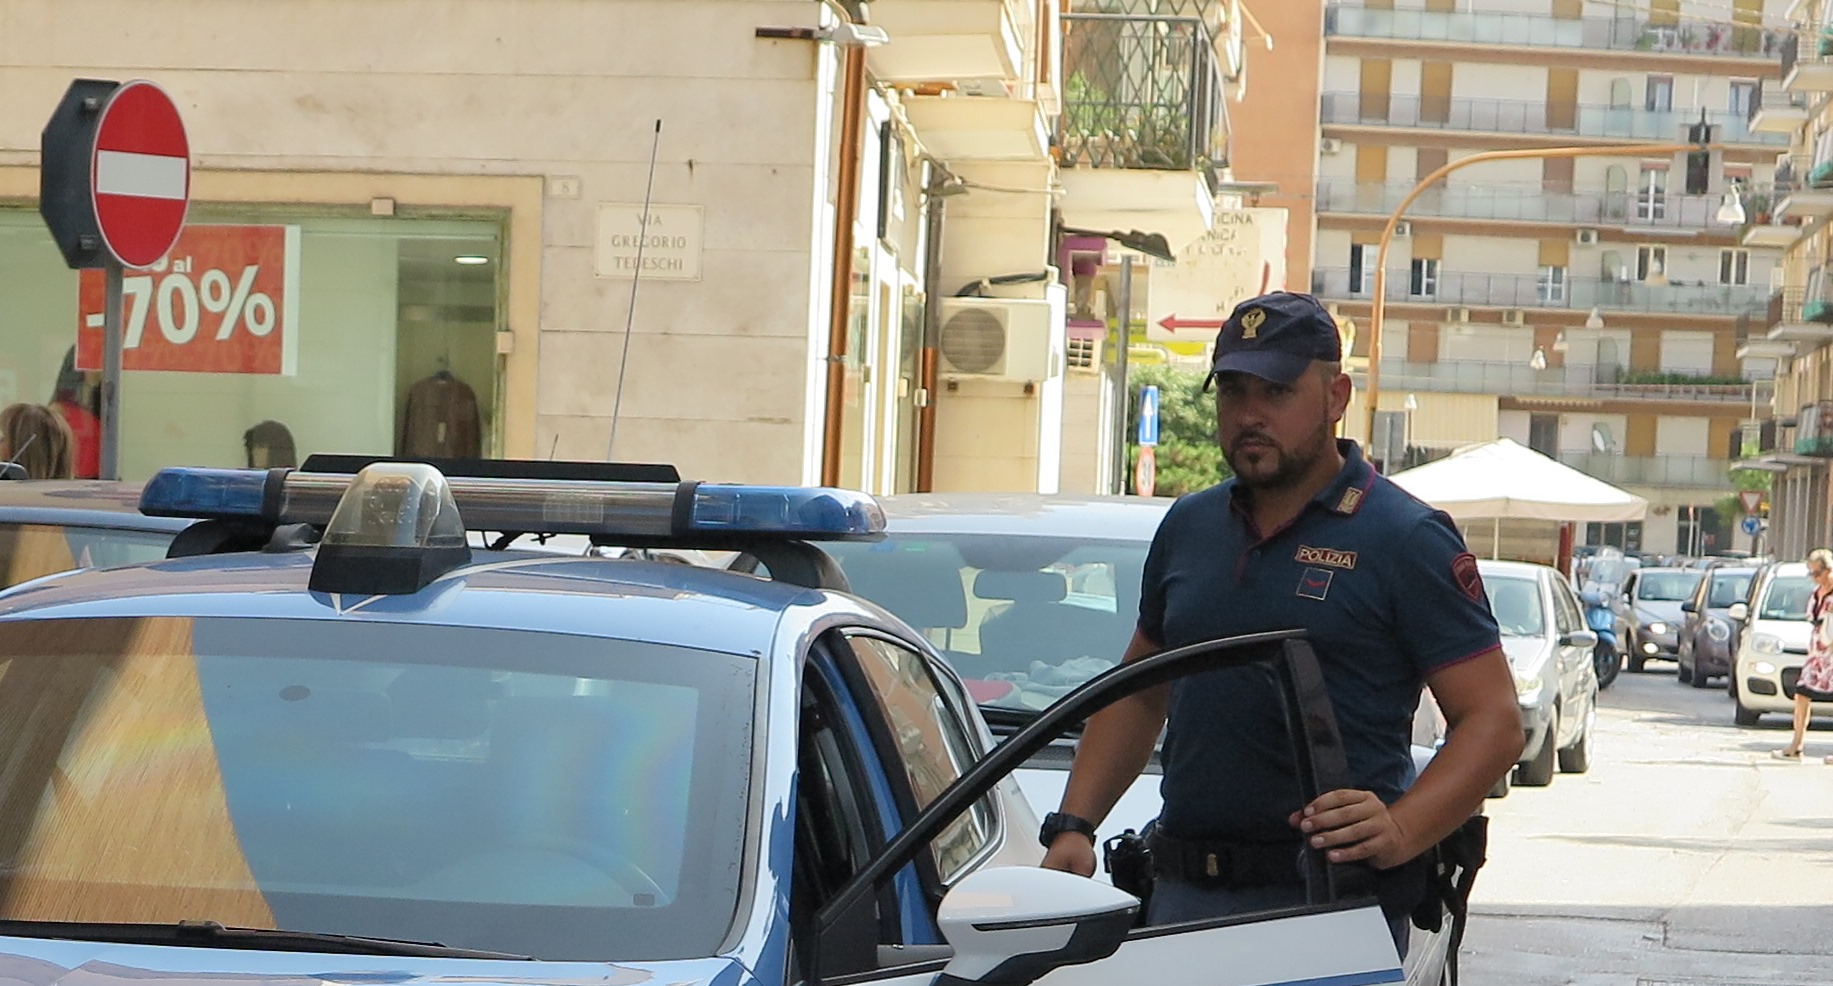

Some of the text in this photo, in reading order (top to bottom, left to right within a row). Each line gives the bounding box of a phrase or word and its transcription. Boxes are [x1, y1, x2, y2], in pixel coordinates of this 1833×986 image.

[636, 213, 663, 226] VIA
[611, 234, 687, 248] GREGORIO
[173, 256, 192, 272] al
[614, 256, 684, 270] TEDESCHI
[86, 264, 276, 349] -70%
[1299, 548, 1353, 567] POLIZIA
